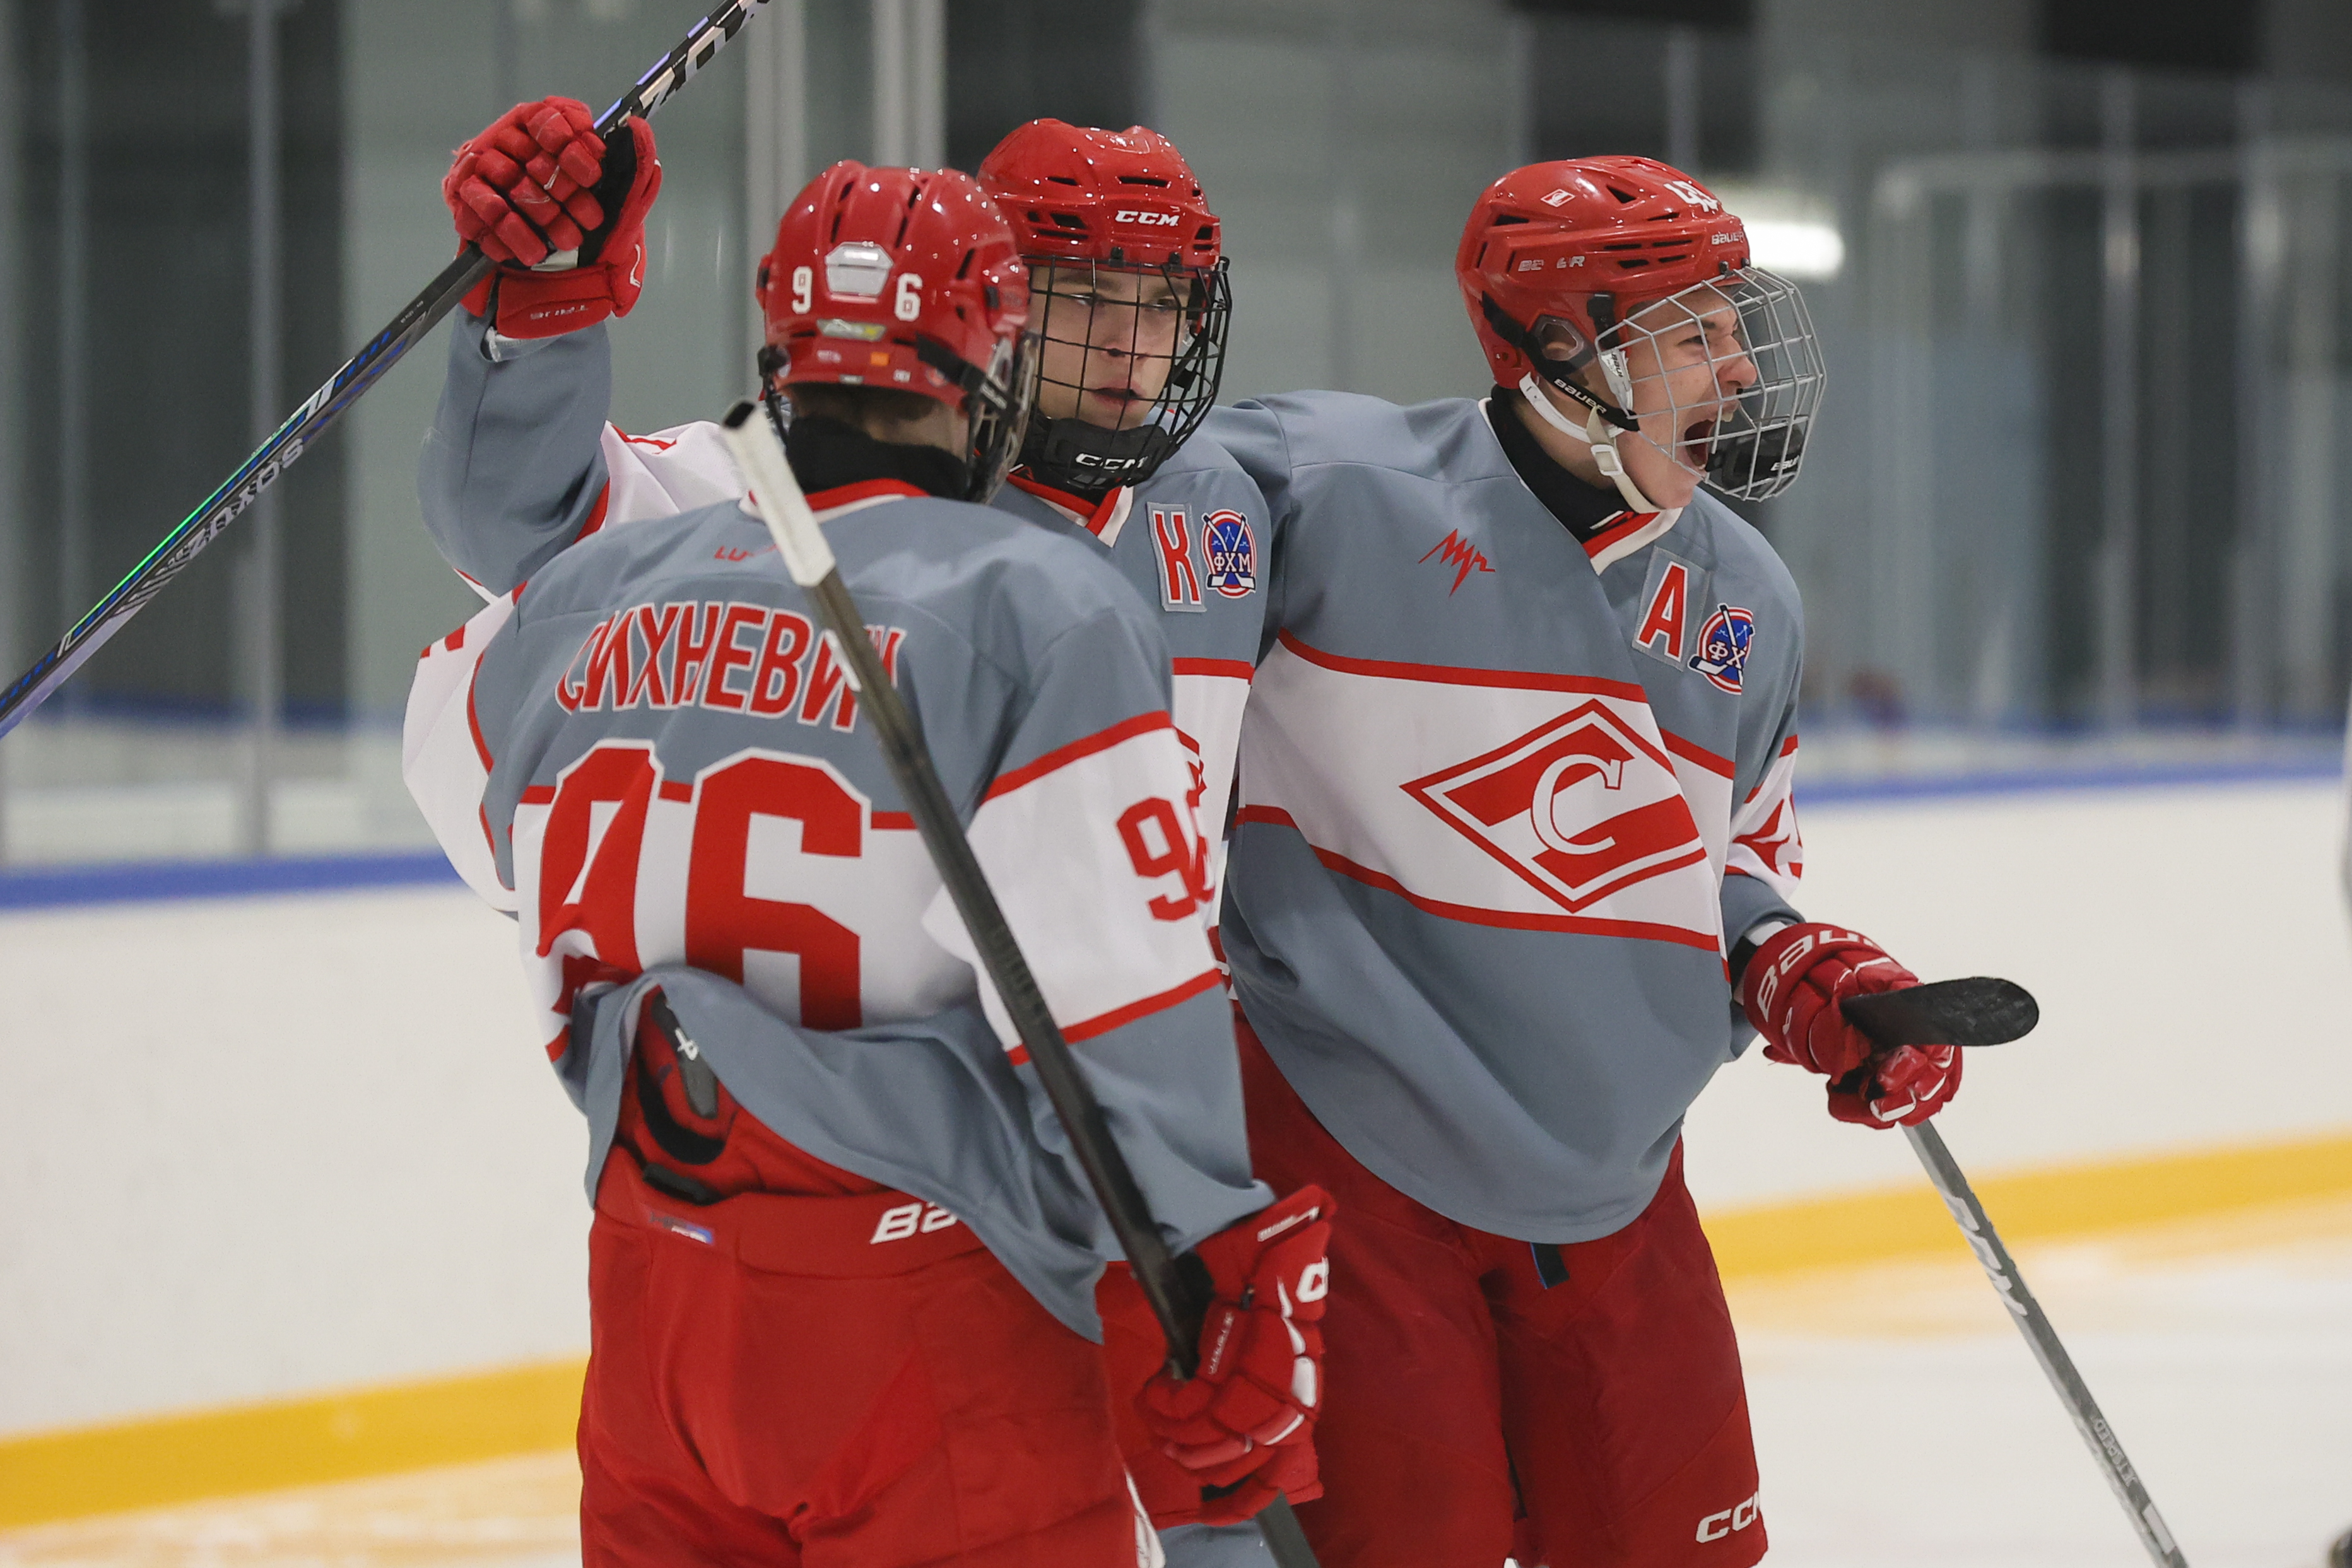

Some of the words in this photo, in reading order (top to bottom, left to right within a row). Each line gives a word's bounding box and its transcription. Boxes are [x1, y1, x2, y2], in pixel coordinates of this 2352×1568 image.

[1115, 210, 1180, 227] CCM
[792, 266, 813, 314] 9
[895, 272, 922, 321] 6
[1554, 378, 1608, 414] BAUER
[1213, 552, 1251, 573] ФХМ
[1707, 640, 1746, 669] ФХ
[1756, 930, 1883, 1022] BAU
